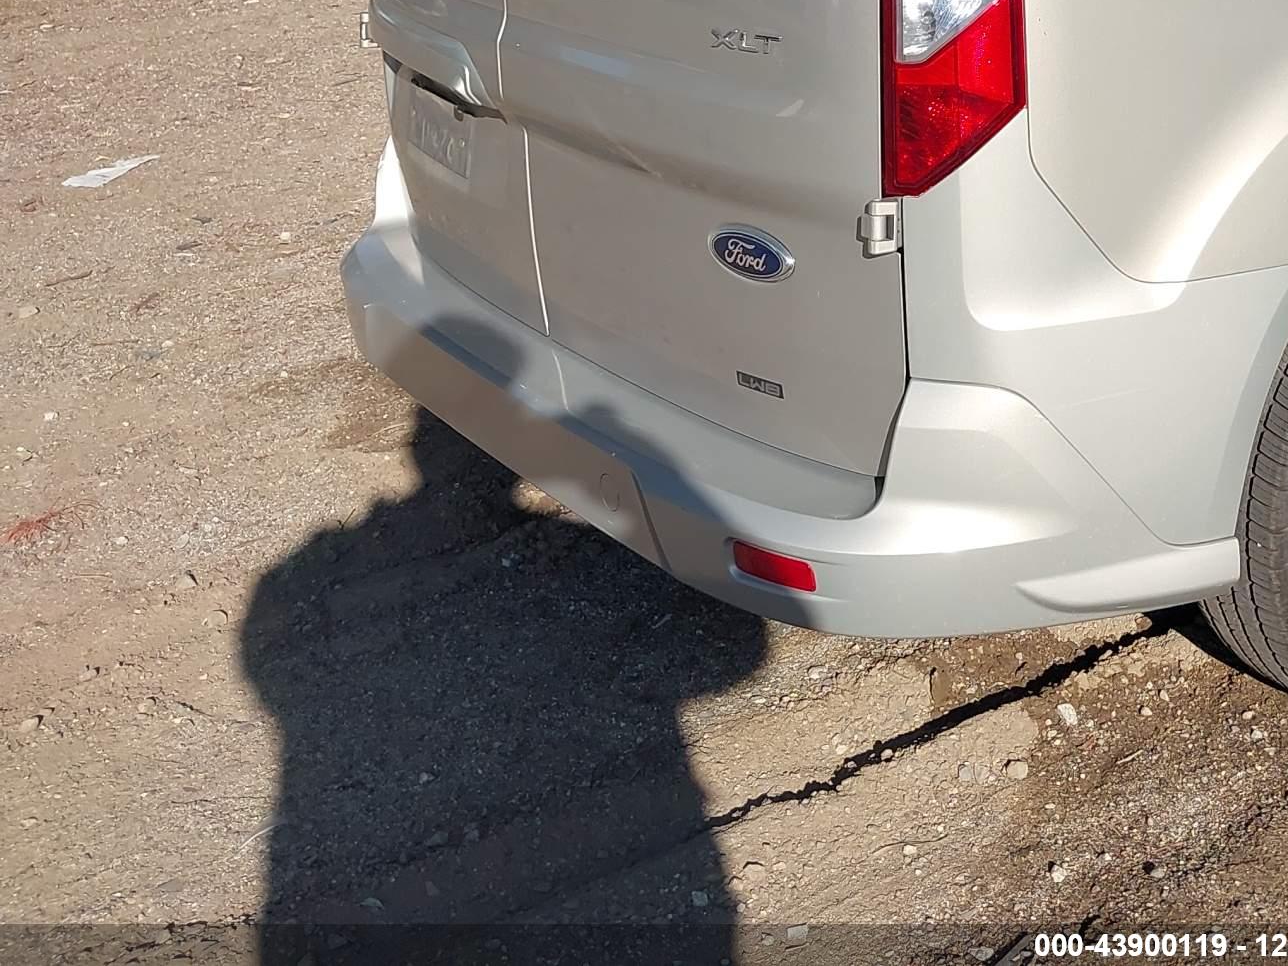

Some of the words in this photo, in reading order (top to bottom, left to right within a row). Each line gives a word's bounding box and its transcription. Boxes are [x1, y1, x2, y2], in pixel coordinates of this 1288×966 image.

[710, 29, 783, 54] XLT
[724, 238, 767, 272] Ford
[739, 373, 780, 396] LWB
